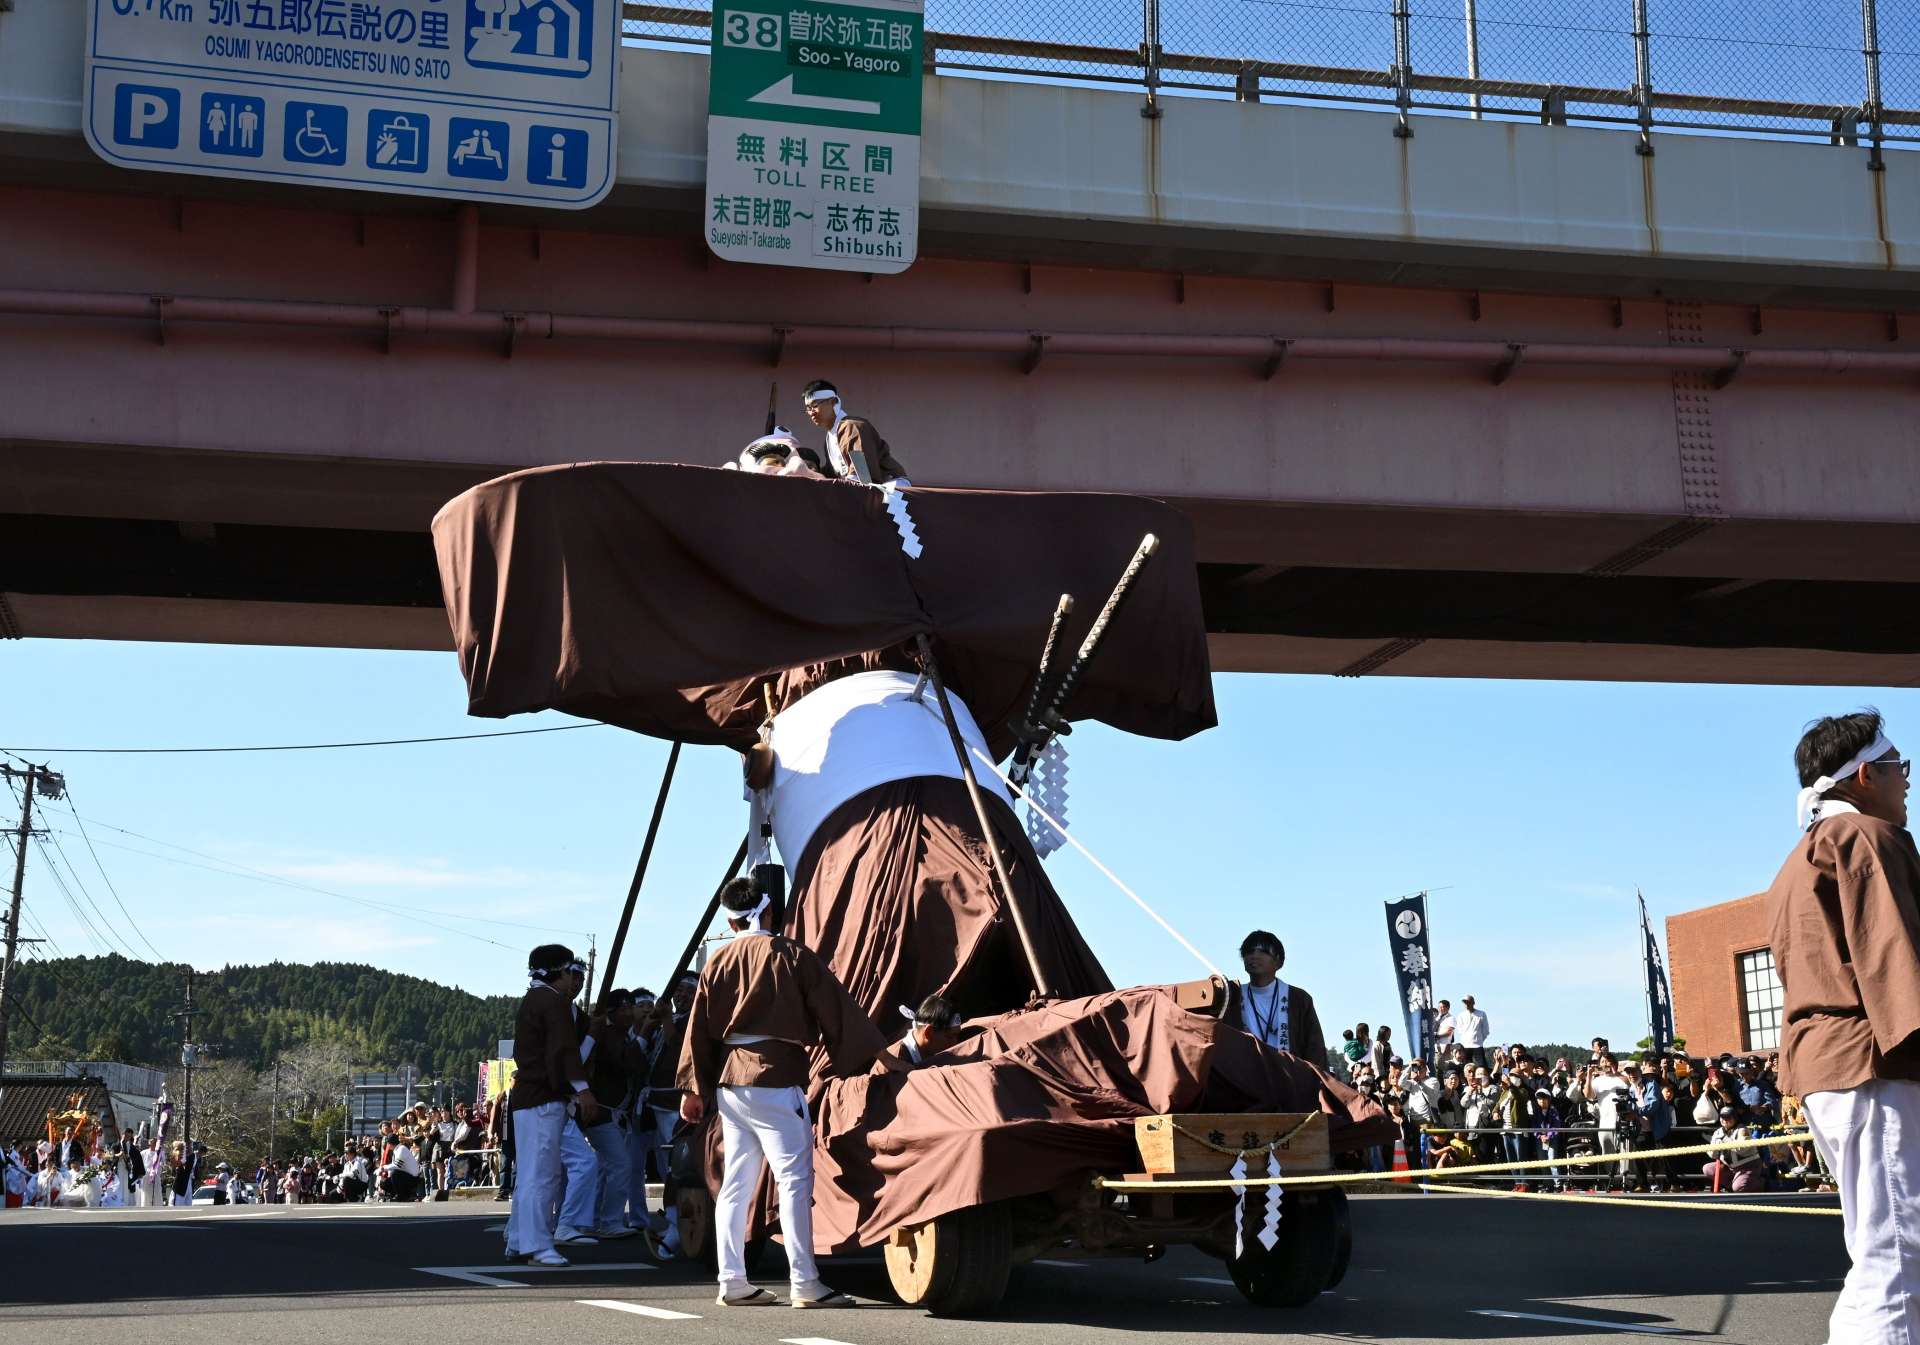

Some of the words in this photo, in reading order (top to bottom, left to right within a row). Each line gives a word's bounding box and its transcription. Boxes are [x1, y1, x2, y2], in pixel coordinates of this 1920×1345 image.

[207, 0, 450, 50] 弥五郎伝説の里
[727, 14, 778, 48] 38
[788, 9, 913, 52] 曽於弥五郎
[205, 35, 250, 59] OSUMI
[256, 40, 385, 74] YAGORODENSETSU
[391, 56, 410, 76] NO
[415, 58, 450, 80] SATO
[130, 93, 169, 140] P
[736, 133, 892, 175] 無料区間
[754, 168, 807, 188] TOLL
[821, 174, 875, 194] FREE
[711, 227, 791, 250] Sueyoshi-Takarabe
[826, 203, 900, 237] 志布志
[823, 236, 902, 258] Shibushi
